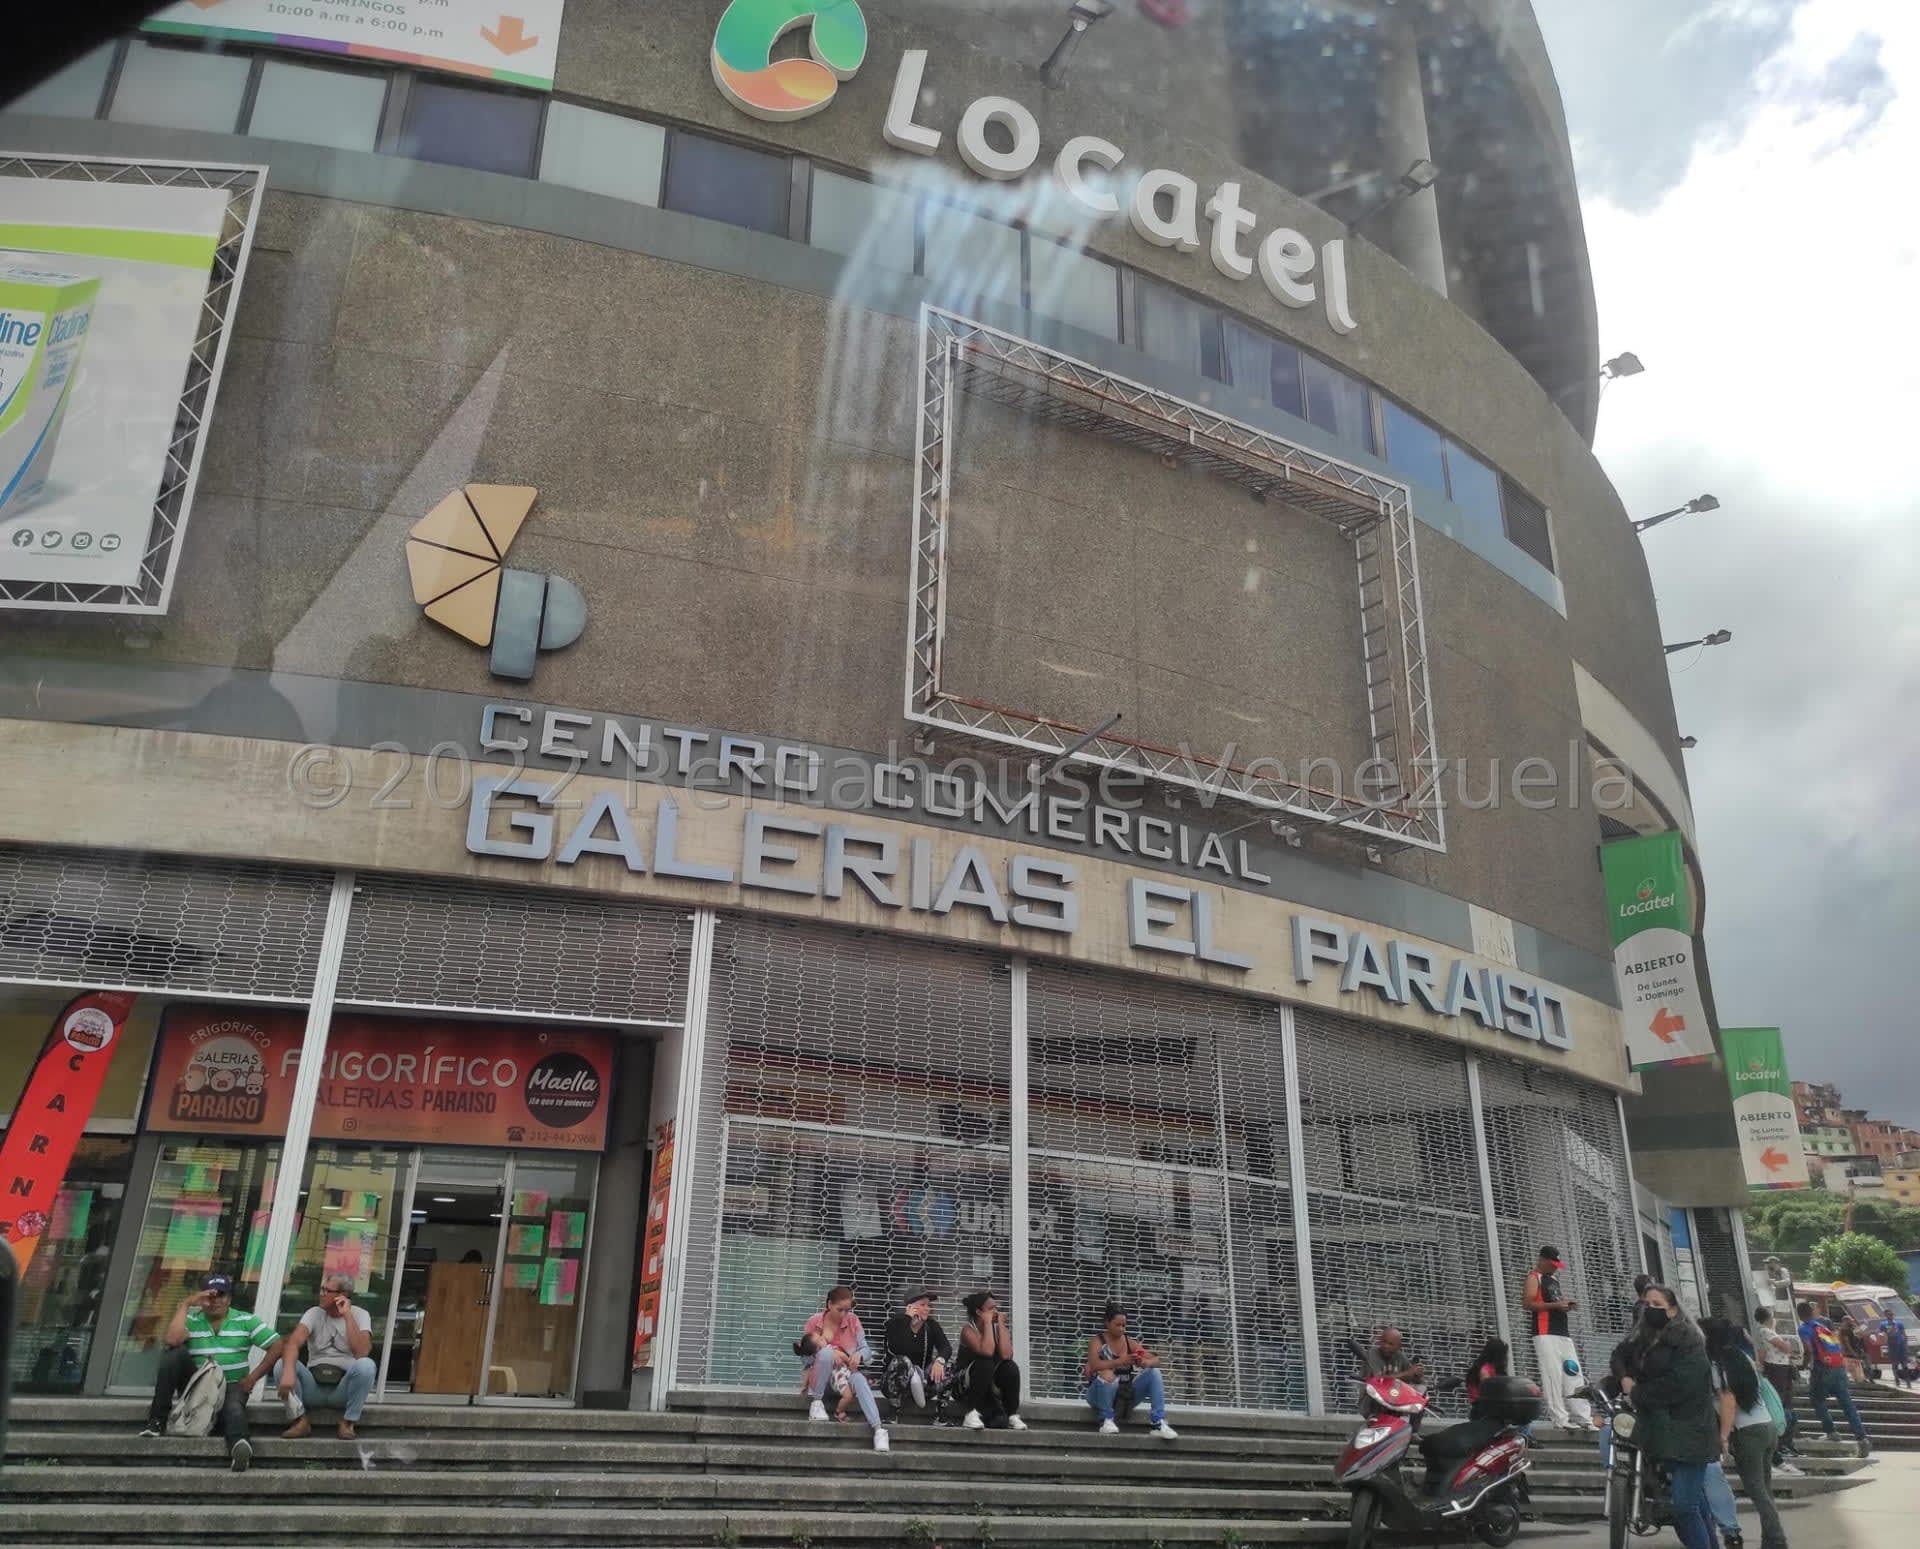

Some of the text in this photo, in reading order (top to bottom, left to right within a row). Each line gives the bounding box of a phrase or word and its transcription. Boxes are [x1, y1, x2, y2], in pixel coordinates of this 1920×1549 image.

[311, 0, 405, 15] MINGOS
[267, 3, 444, 38] 10:00 a.m a 6:00 p.m
[883, 49, 1357, 335] Locatel
[480, 703, 1271, 884] CENTRO COMERCIAL
[466, 777, 1573, 1051] GALERIAS EL PARAISO
[1620, 893, 1675, 917] Locatel
[1624, 953, 1687, 976] ABIERTO
[1637, 977, 1678, 992] De Lunes
[1645, 986, 1684, 1001] Domingo
[194, 1051, 259, 1066] GALERIAS
[280, 1046, 518, 1088] FIGORÍFICO
[528, 1067, 598, 1093] Maella
[1735, 1069, 1781, 1081] Locatel
[177, 1094, 260, 1120] PARAISO
[313, 1086, 497, 1114] ALERIAS PARAISO
[1740, 1111, 1792, 1122] ABIERTO
